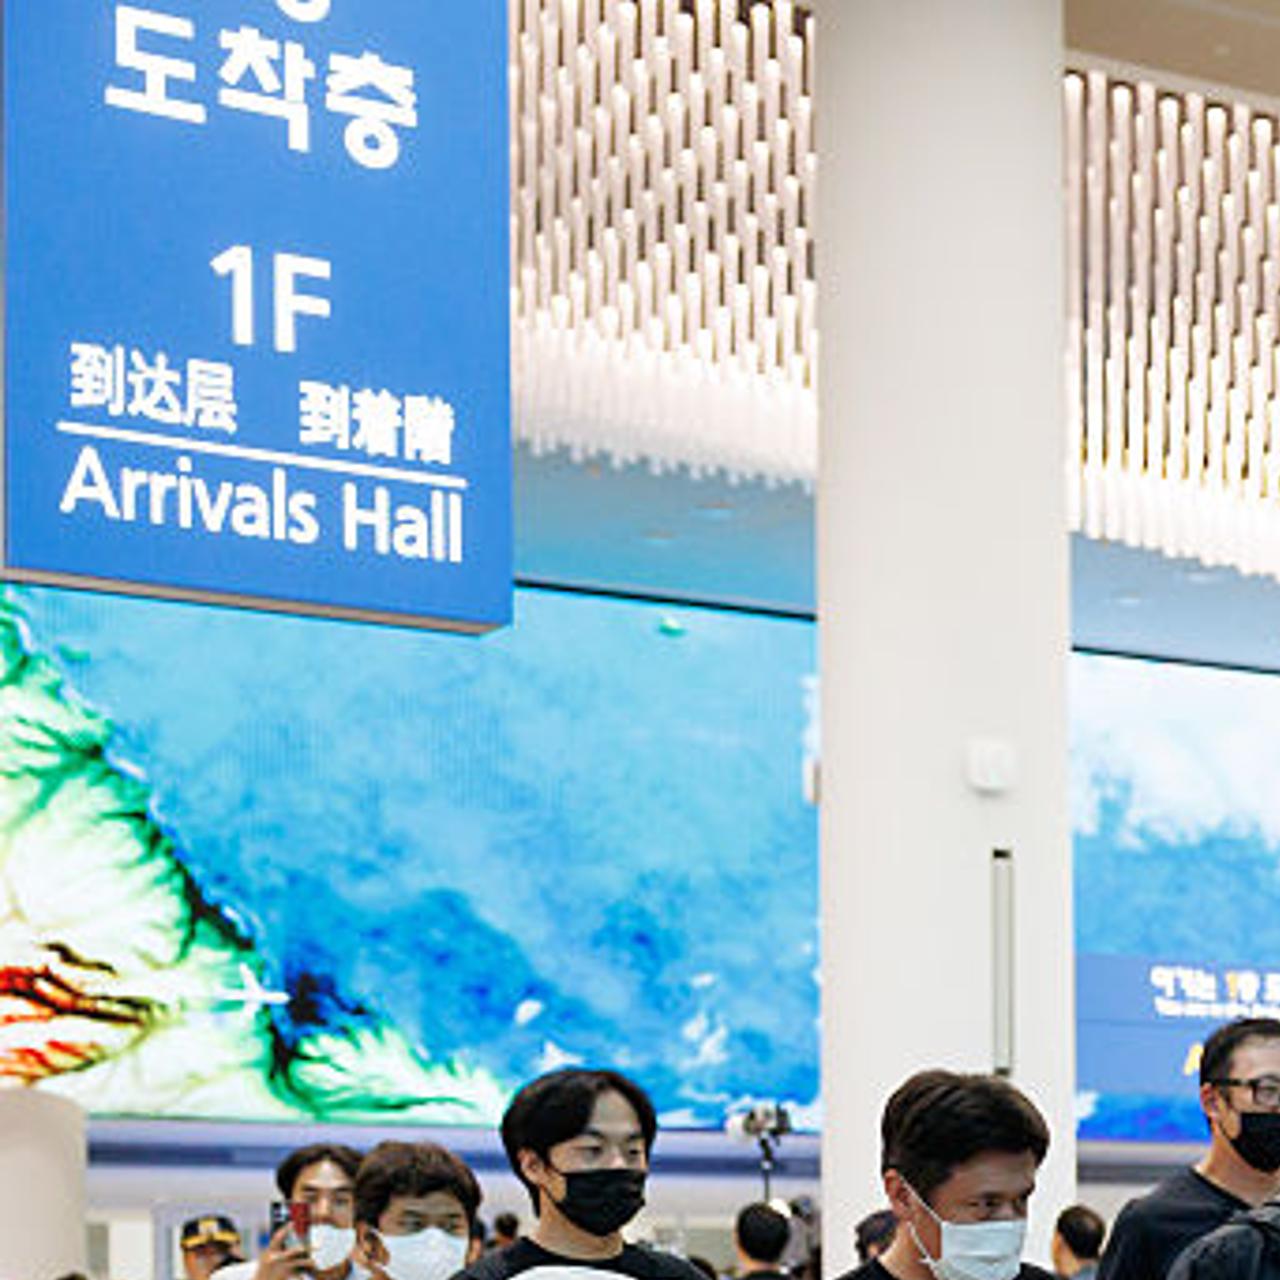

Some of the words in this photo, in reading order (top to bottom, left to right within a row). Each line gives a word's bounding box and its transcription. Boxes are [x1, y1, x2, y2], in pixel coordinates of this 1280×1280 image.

[104, 4, 418, 169] 도착층
[209, 245, 331, 353] 1F
[70, 342, 237, 433] 到达层
[59, 445, 320, 544] Arrivals
[343, 482, 462, 563] Hall
